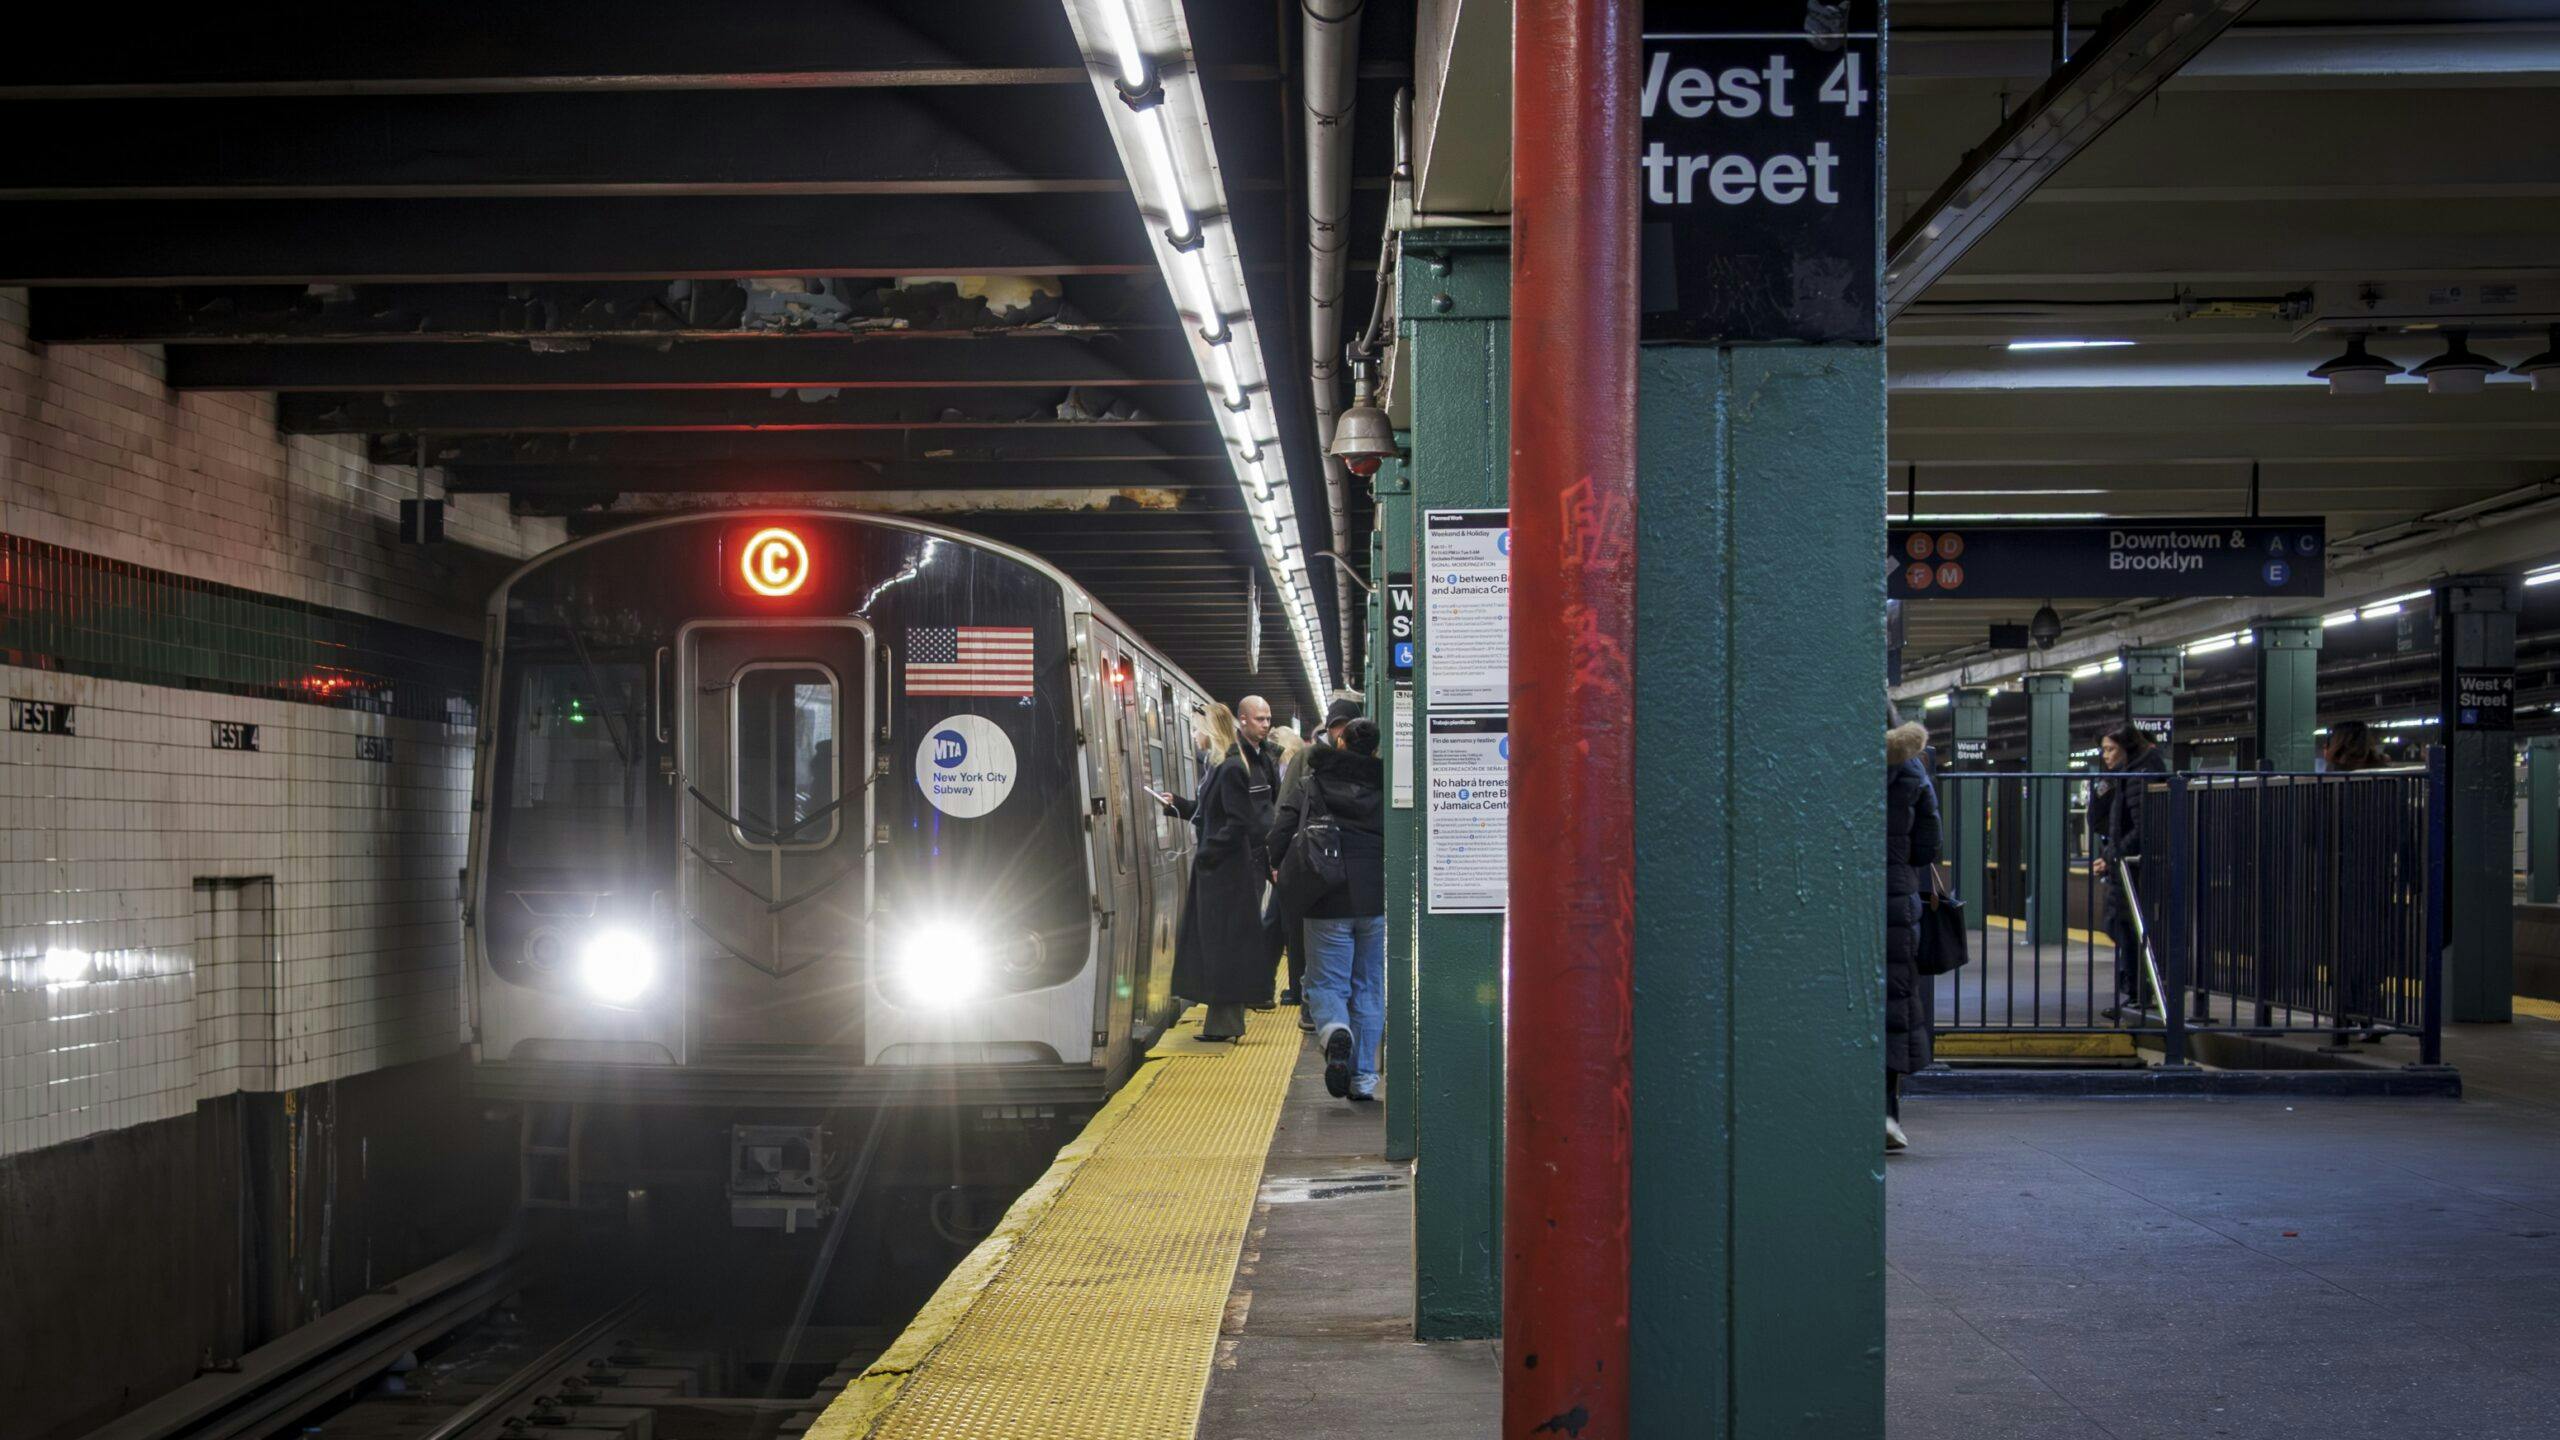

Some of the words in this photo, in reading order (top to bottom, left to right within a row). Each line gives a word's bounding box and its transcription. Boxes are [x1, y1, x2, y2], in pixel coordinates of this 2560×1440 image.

[1819, 53, 1868, 117] 4
[1642, 142, 1839, 204] treet
[1467, 530, 1489, 538] Holiday
[2109, 531, 2221, 549] Downtown
[2230, 530, 2246, 548] &
[1914, 538, 1926, 553] B
[1945, 538, 1958, 553] D
[2270, 535, 2284, 551] A
[2300, 534, 2315, 551] C
[761, 542, 789, 583] C
[2109, 551, 2204, 573] Brooklyn
[1431, 575, 1445, 583] No
[1459, 574, 1500, 583] between
[1914, 569, 1926, 584] F
[1943, 568, 1957, 583] M
[2269, 565, 2282, 581] E
[1431, 586, 1449, 595] and
[1450, 585, 1489, 595] Jamaica
[2460, 677, 2499, 691] West
[2503, 677, 2512, 691] 4
[2460, 692, 2507, 706] Street
[9, 700, 55, 732] WEST
[65, 706, 76, 734] 4
[2134, 720, 2161, 731] West
[2163, 720, 2171, 731] 4
[211, 722, 244, 749] WEST
[251, 727, 260, 750] 4
[933, 738, 962, 760] MTA
[1957, 742, 1979, 751] West
[1980, 742, 1987, 750] 4
[1957, 751, 1984, 760] Street
[933, 772, 957, 782] New
[960, 772, 983, 782] York
[986, 772, 1007, 784] City
[1433, 778, 1447, 787] No
[1448, 777, 1477, 787] habrá
[933, 784, 974, 796] Subway
[1472, 790, 1499, 798] entre
[1433, 803, 1439, 811] y
[1440, 801, 1481, 810] Jamaica
[1482, 801, 1509, 810] Cent
